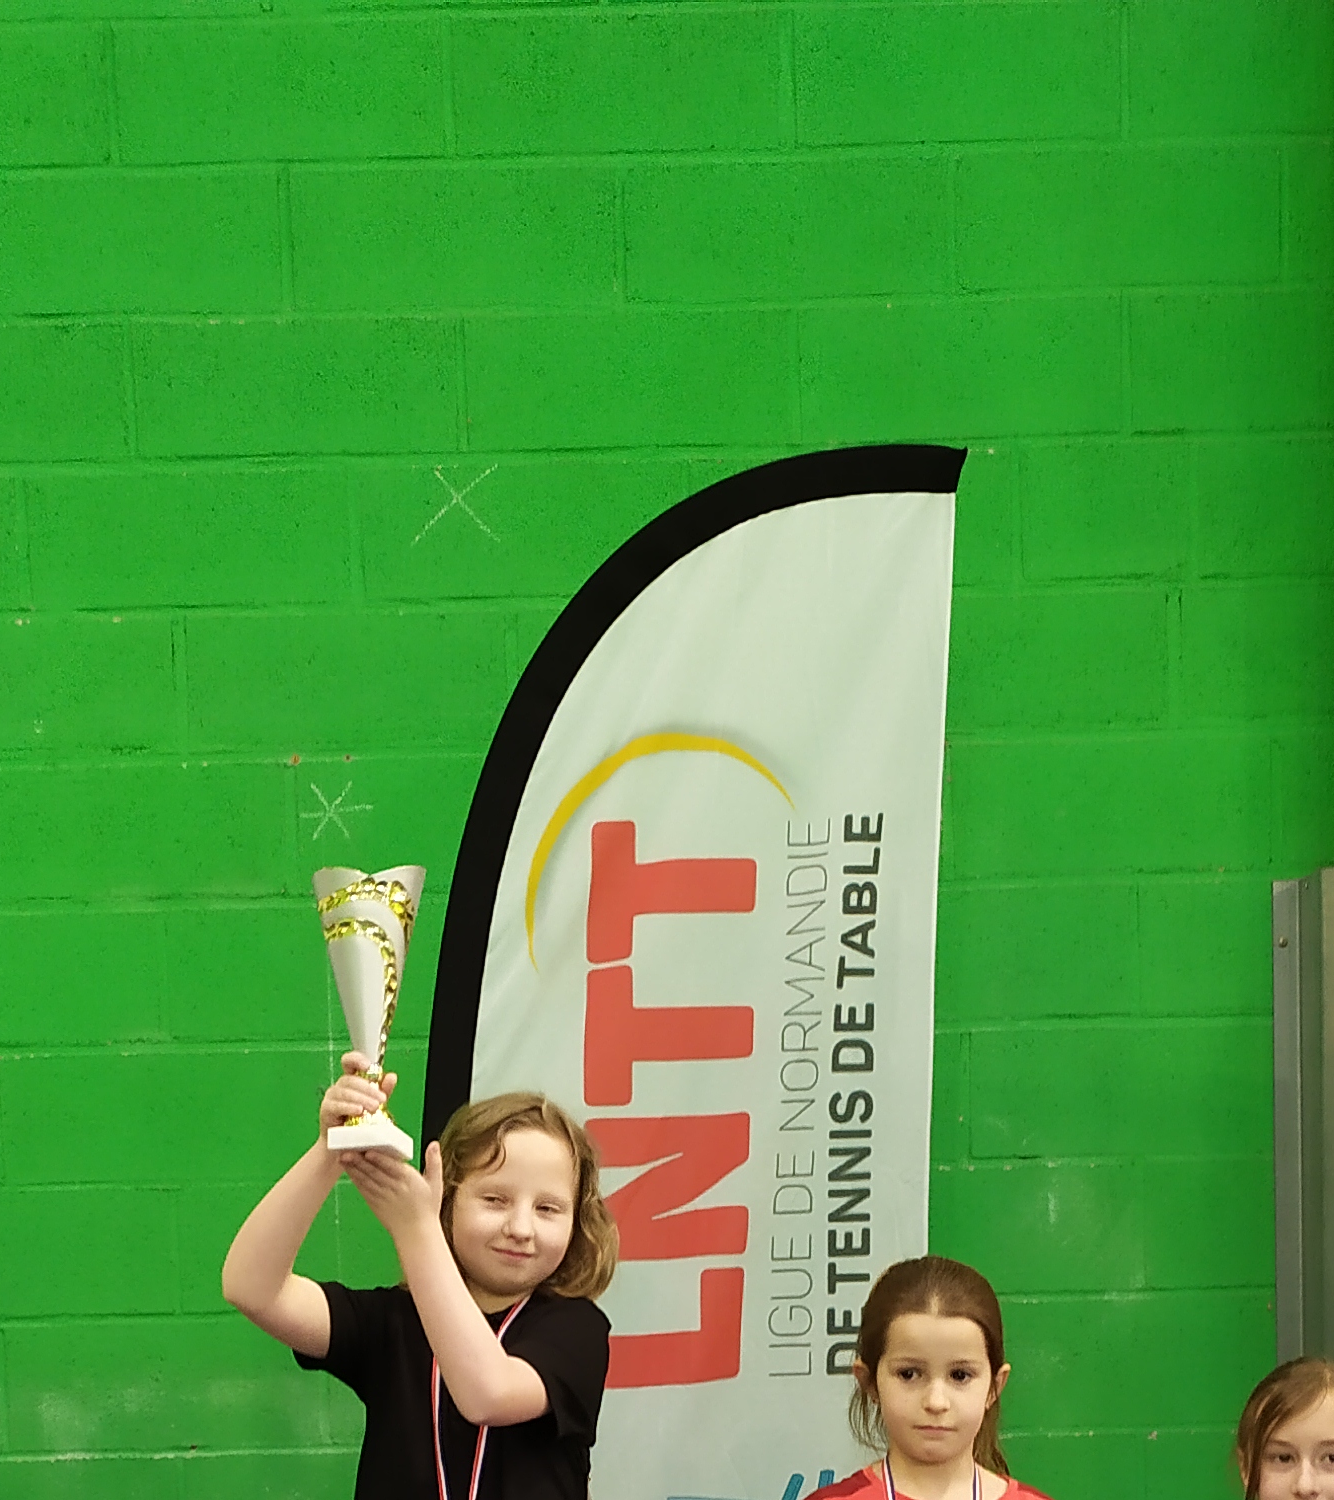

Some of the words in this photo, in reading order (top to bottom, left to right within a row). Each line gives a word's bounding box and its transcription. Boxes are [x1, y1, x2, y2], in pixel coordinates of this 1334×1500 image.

[779, 817, 830, 1131] NORMANDIE
[836, 812, 884, 989] TABLE
[584, 819, 757, 1389] LNTT
[831, 1002, 874, 1073] DE
[773, 1150, 815, 1215] DE
[827, 1090, 874, 1294] TENNIS
[768, 1233, 813, 1377] LIGUE
[826, 1307, 864, 1375] DE
